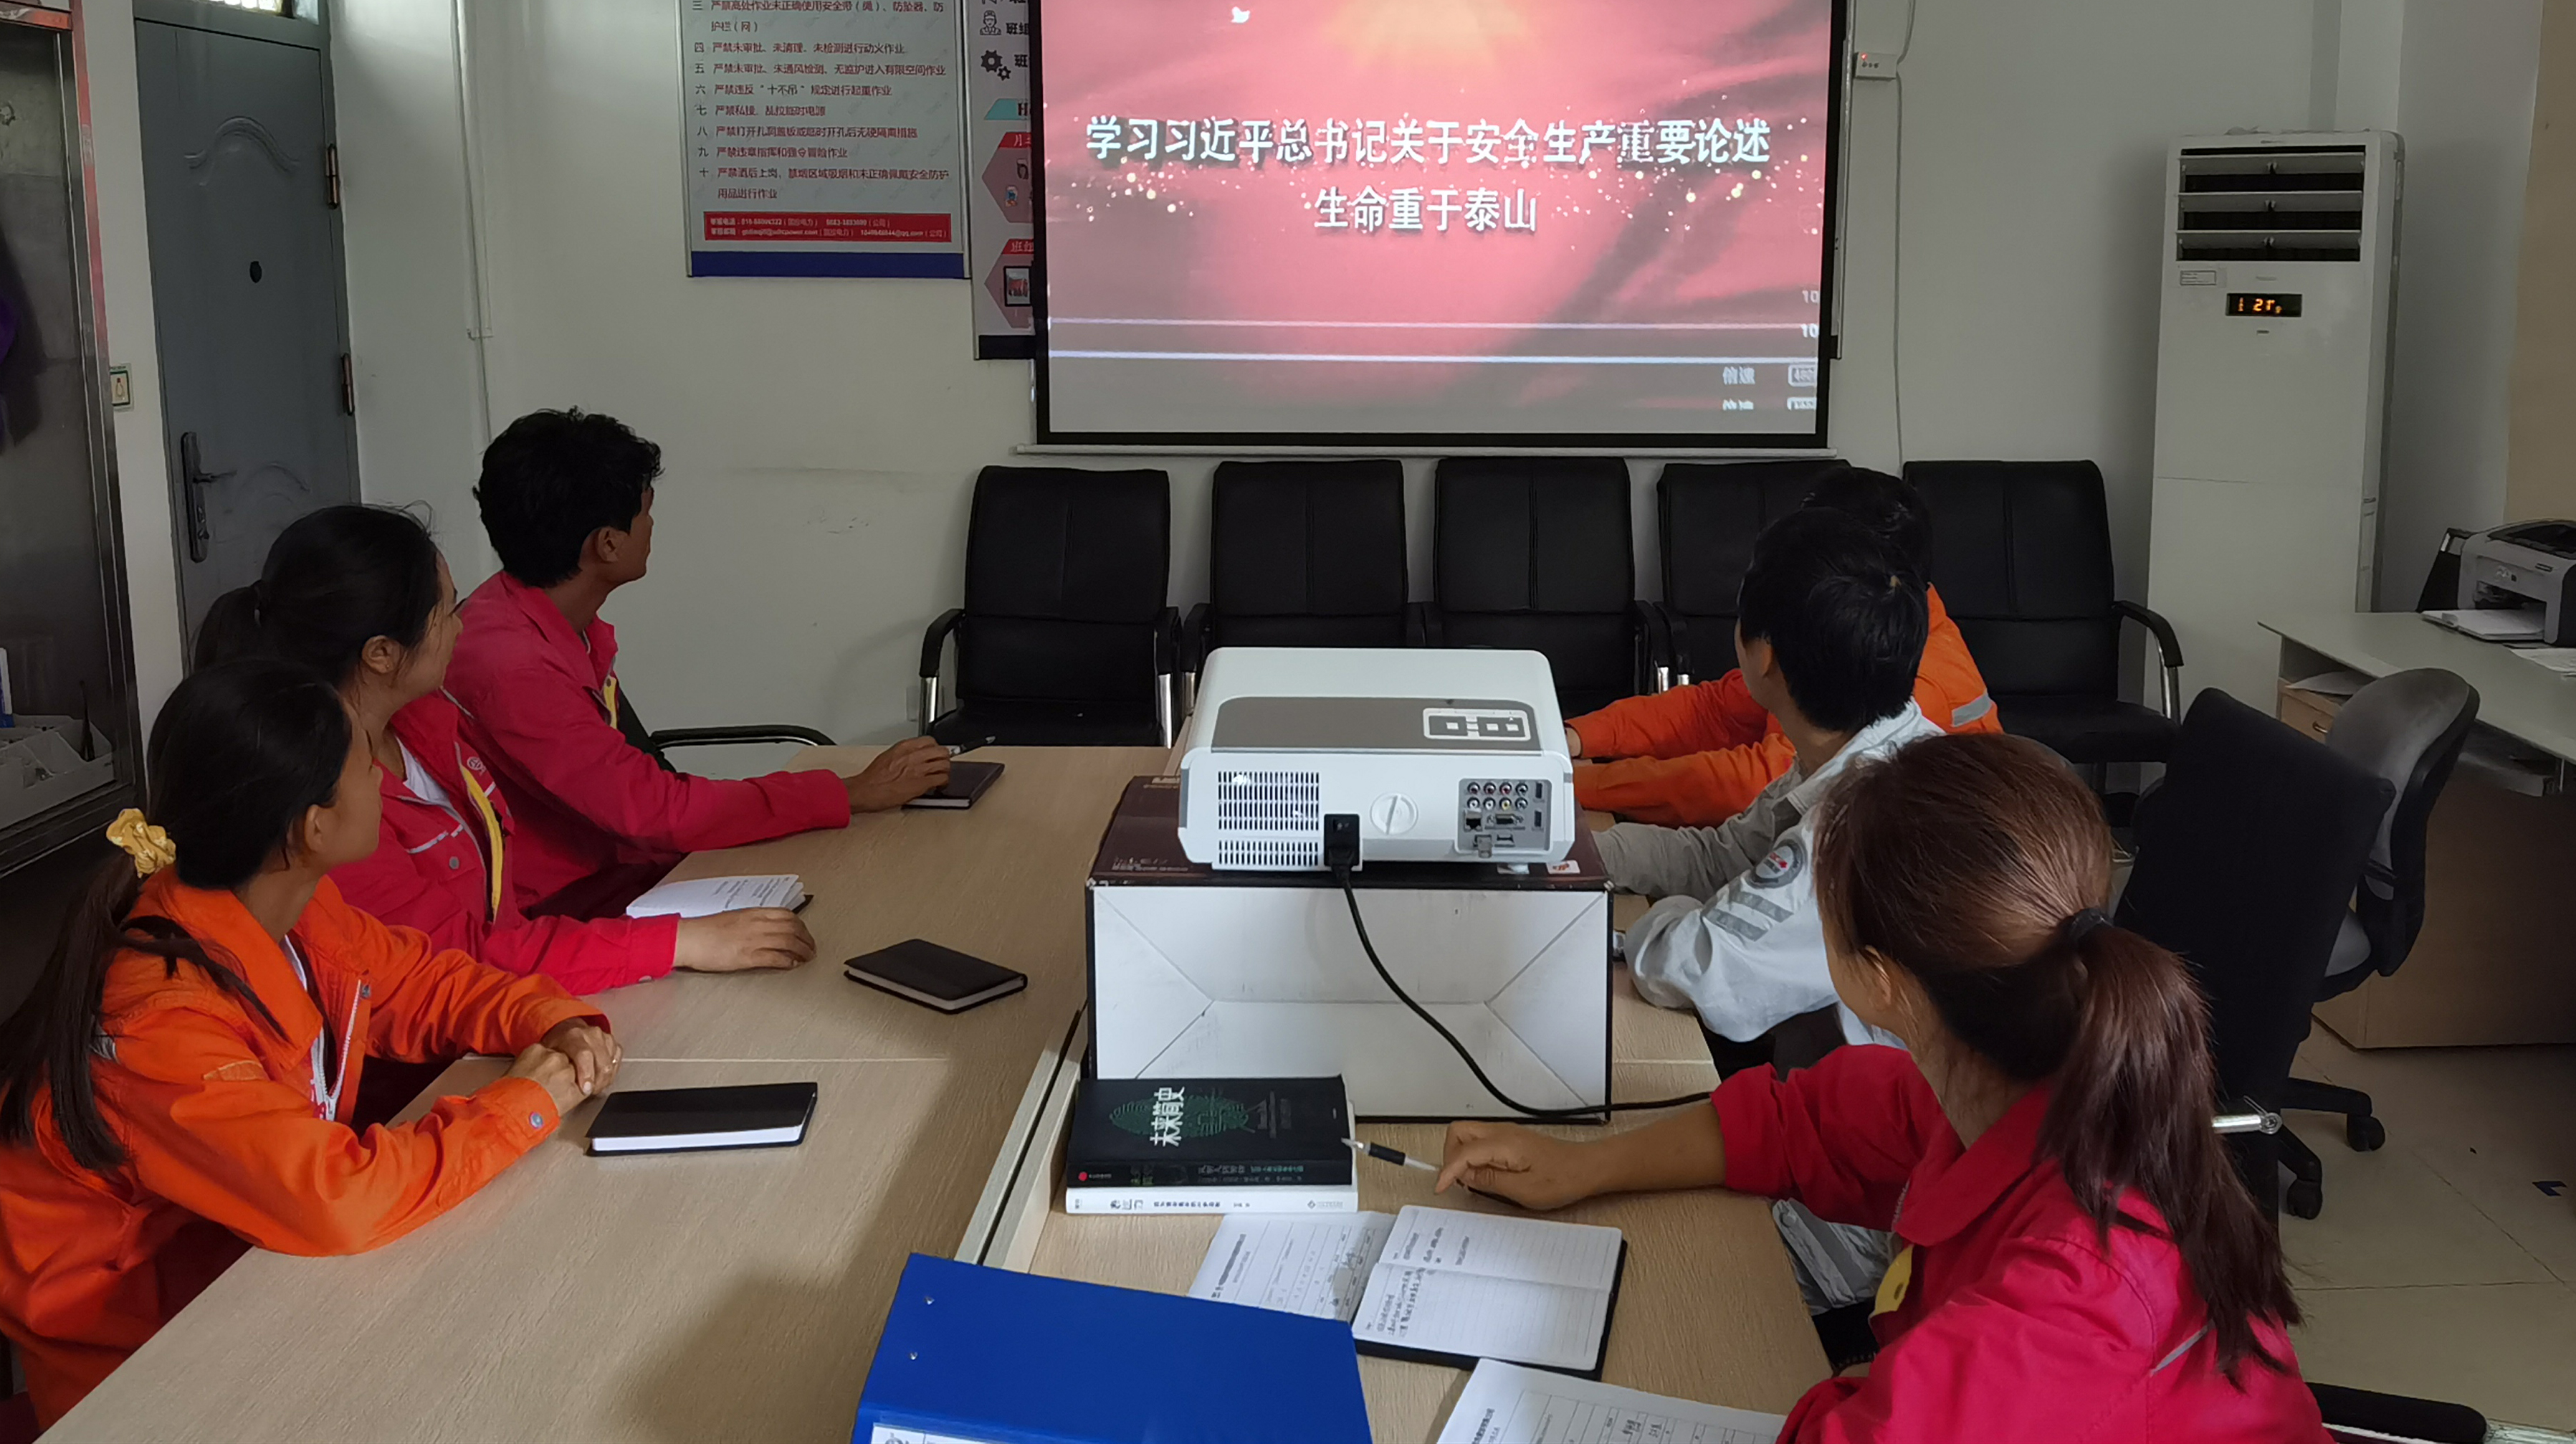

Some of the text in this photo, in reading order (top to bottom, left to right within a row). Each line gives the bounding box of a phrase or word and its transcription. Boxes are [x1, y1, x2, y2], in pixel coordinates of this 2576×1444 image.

[692, 1, 703, 10] 三
[695, 42, 705, 52] 四
[695, 63, 705, 74] 五
[695, 84, 706, 95] 六
[697, 105, 707, 116] 七
[697, 126, 708, 136] 八
[1087, 115, 1770, 164] 学习习近平总书记关于安全生产重要论述
[698, 147, 709, 158] 九
[699, 168, 709, 177] 十
[1314, 185, 1536, 232] 生命重于泰山
[1149, 1086, 1186, 1147] 未来简史
